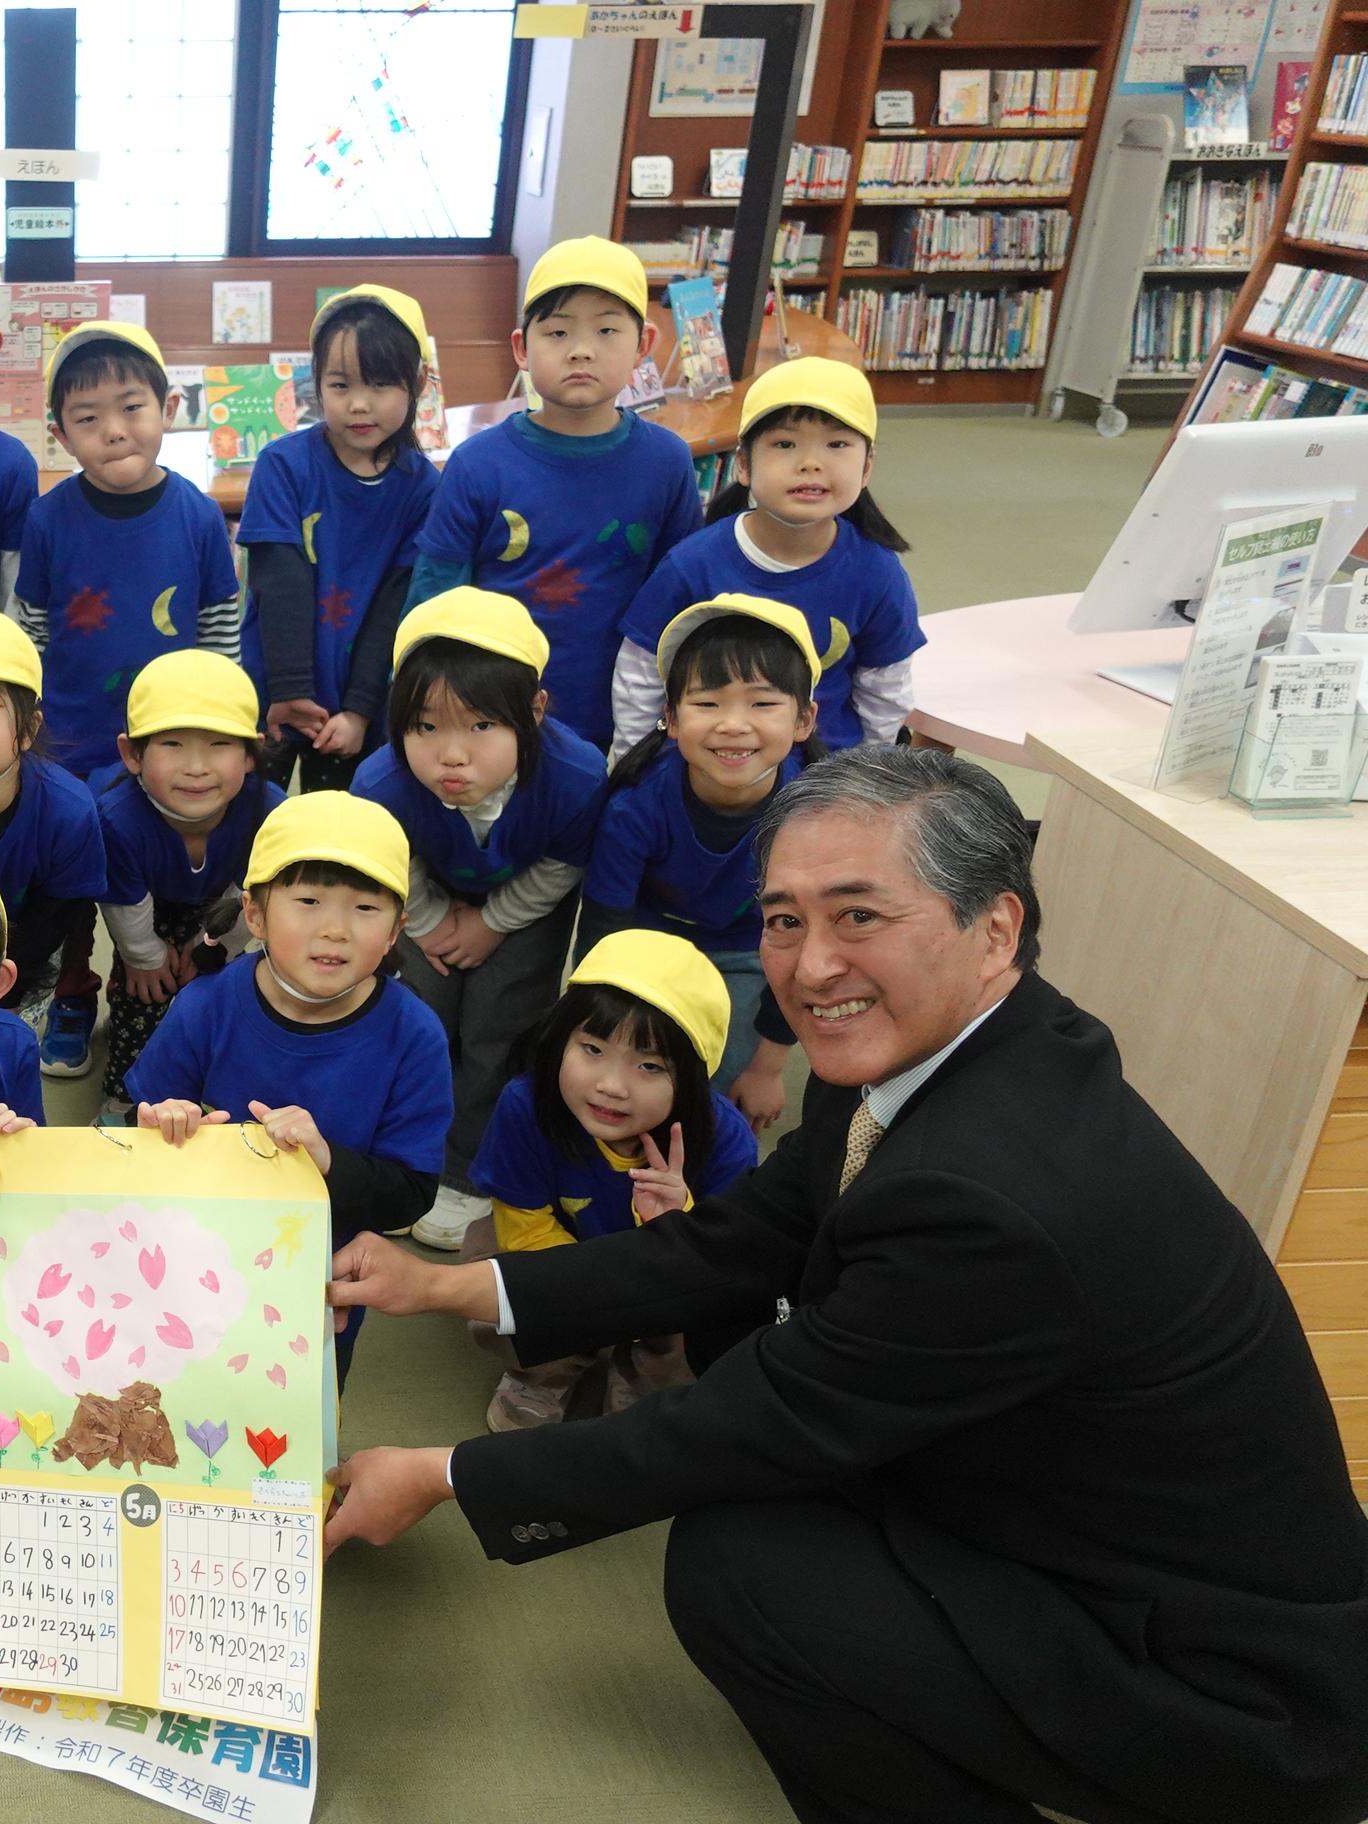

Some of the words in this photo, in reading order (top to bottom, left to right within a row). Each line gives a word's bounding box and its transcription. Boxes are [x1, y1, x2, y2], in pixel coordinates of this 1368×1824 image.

[1197, 145, 1262, 158] おおきなえほん
[16, 159, 60, 175] えほん
[125, 1492, 156, 1521] 5月
[169, 1503, 184, 1514] にち
[231, 1508, 246, 1519] すい
[273, 1513, 292, 1525] きん
[43, 1511, 47, 1527] 1
[59, 1514, 71, 1528] 2
[80, 1515, 91, 1536] 3
[103, 1517, 114, 1536] 4
[4, 1542, 15, 1563] 6
[23, 1548, 33, 1568] 7
[43, 1549, 53, 1569] 8
[62, 1555, 70, 1568] 9
[82, 1553, 95, 1568] 10
[101, 1555, 112, 1568] 11
[276, 1531, 282, 1552] 1
[296, 1535, 308, 1559] 2
[171, 1559, 181, 1582] 3
[190, 1560, 205, 1583] 4
[213, 1564, 223, 1585] 5
[232, 1562, 247, 1588] 6
[253, 1567, 266, 1591] 7
[275, 1569, 290, 1594] 8
[295, 1571, 305, 1594] 9
[2, 1580, 14, 1597] 13
[22, 1581, 33, 1600] 14
[41, 1584, 55, 1601] 15
[61, 1588, 73, 1605] 16
[84, 1592, 95, 1608] 17
[101, 1589, 113, 1605] 18
[1, 1614, 18, 1629] 20
[23, 1616, 35, 1628] 21
[40, 1620, 56, 1631] 22
[60, 1621, 77, 1642] 23
[81, 1624, 95, 1642] 24
[100, 1624, 115, 1637] 25
[169, 1594, 185, 1618] 10
[190, 1594, 204, 1619] 11
[210, 1596, 225, 1619] 12
[231, 1601, 245, 1621] 13
[252, 1602, 267, 1626] 14
[273, 1603, 287, 1629] 15
[293, 1610, 307, 1637] 16
[169, 1627, 185, 1654] 17
[189, 1630, 204, 1652] 18
[209, 1634, 224, 1656] 19
[228, 1637, 246, 1658] 20
[249, 1642, 265, 1663] 21
[269, 1645, 285, 1662] 22
[290, 1651, 305, 1668] 23
[39, 1654, 57, 1675] 29
[60, 1655, 77, 1677] 30
[171, 1683, 181, 1695] 31
[187, 1669, 203, 1689] 25
[205, 1674, 222, 1691] 26
[227, 1678, 244, 1697] 27
[248, 1683, 263, 1697] 28
[267, 1683, 282, 1700] 29
[288, 1691, 303, 1713] 30
